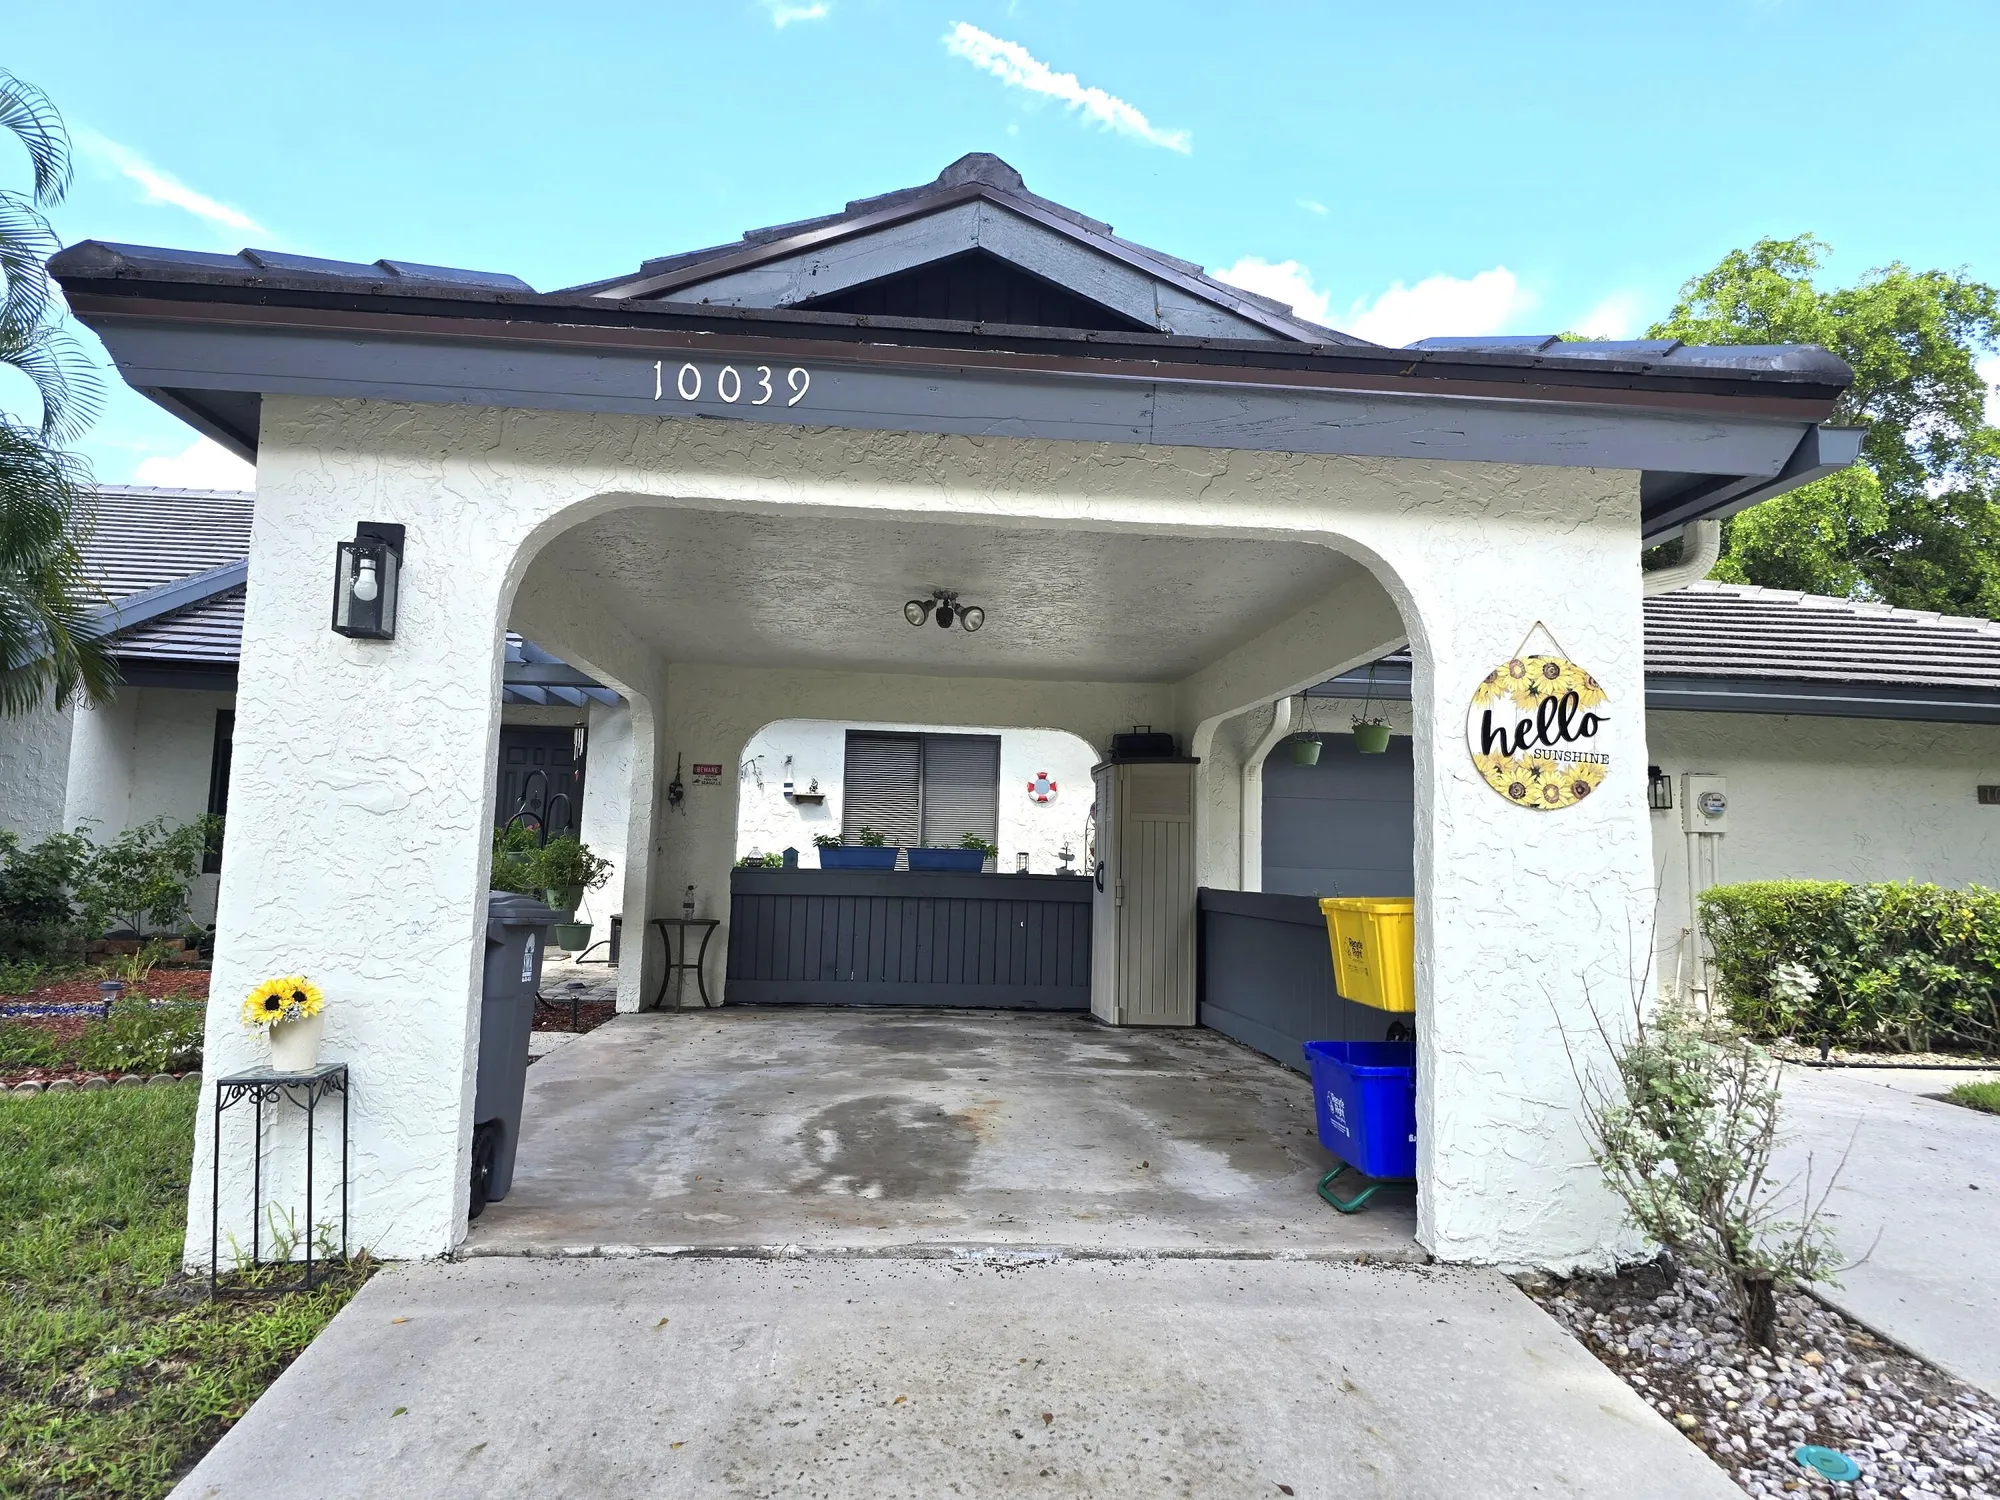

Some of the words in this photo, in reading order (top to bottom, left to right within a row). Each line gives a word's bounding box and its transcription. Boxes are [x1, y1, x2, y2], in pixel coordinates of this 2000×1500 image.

[653, 360, 811, 408] 10039
[1480, 691, 1611, 758] hello
[1533, 748, 1610, 765] SUNSHINE
